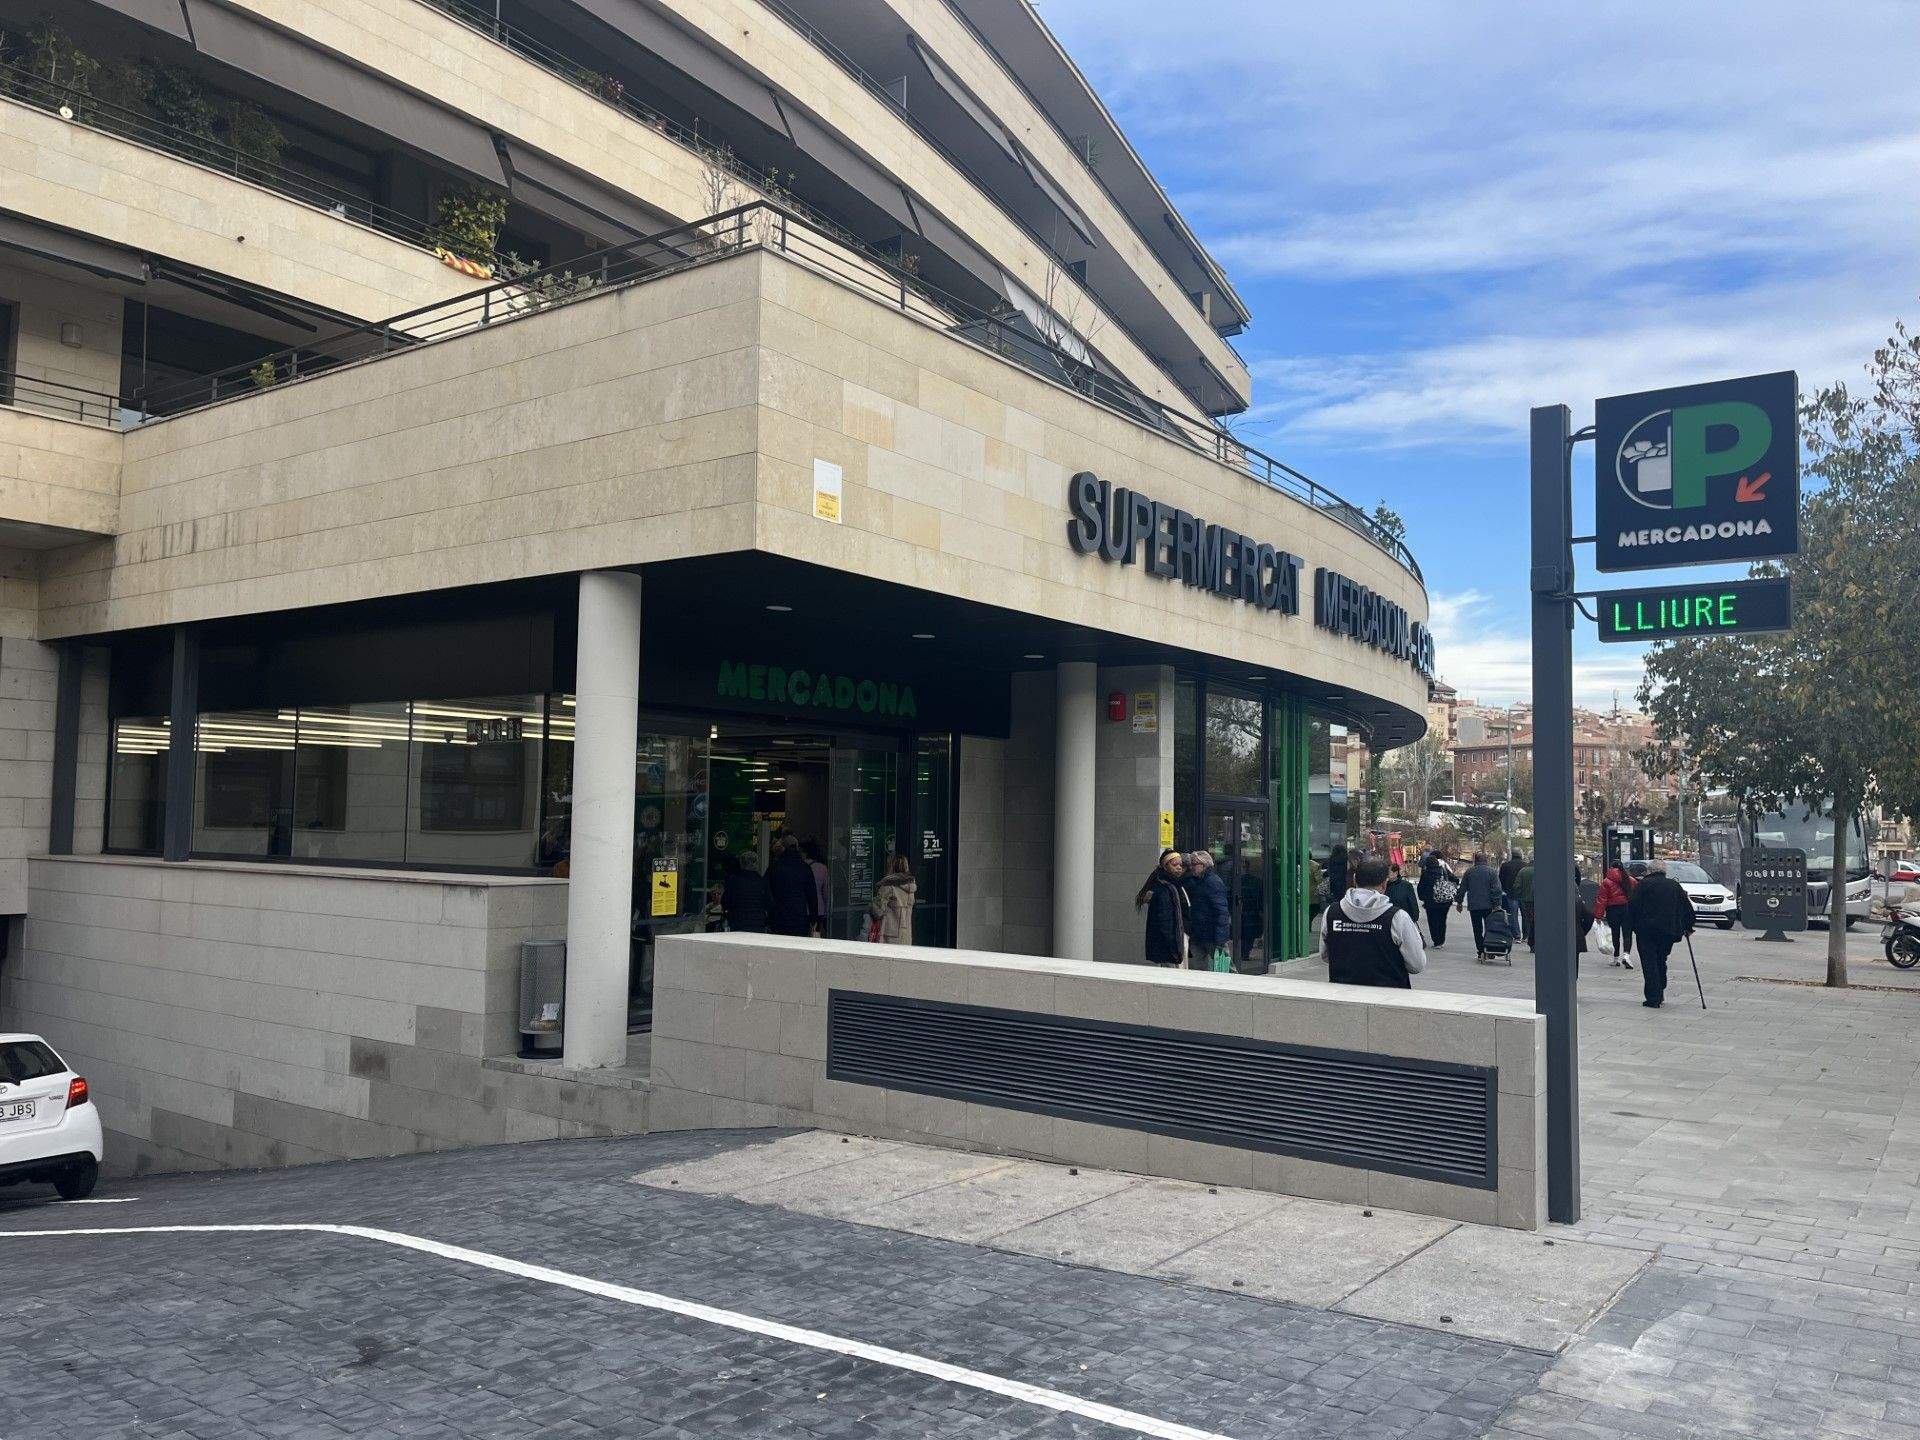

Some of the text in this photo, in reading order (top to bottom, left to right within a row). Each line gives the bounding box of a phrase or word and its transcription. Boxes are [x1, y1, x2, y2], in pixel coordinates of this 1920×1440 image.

[1067, 471, 1304, 615] SUPERMERCAT
[1618, 518, 1772, 547] MERCADONA
[1614, 594, 1737, 632] LLIURE
[717, 660, 917, 718] MERCADONA
[10, 1104, 32, 1116] JBS
